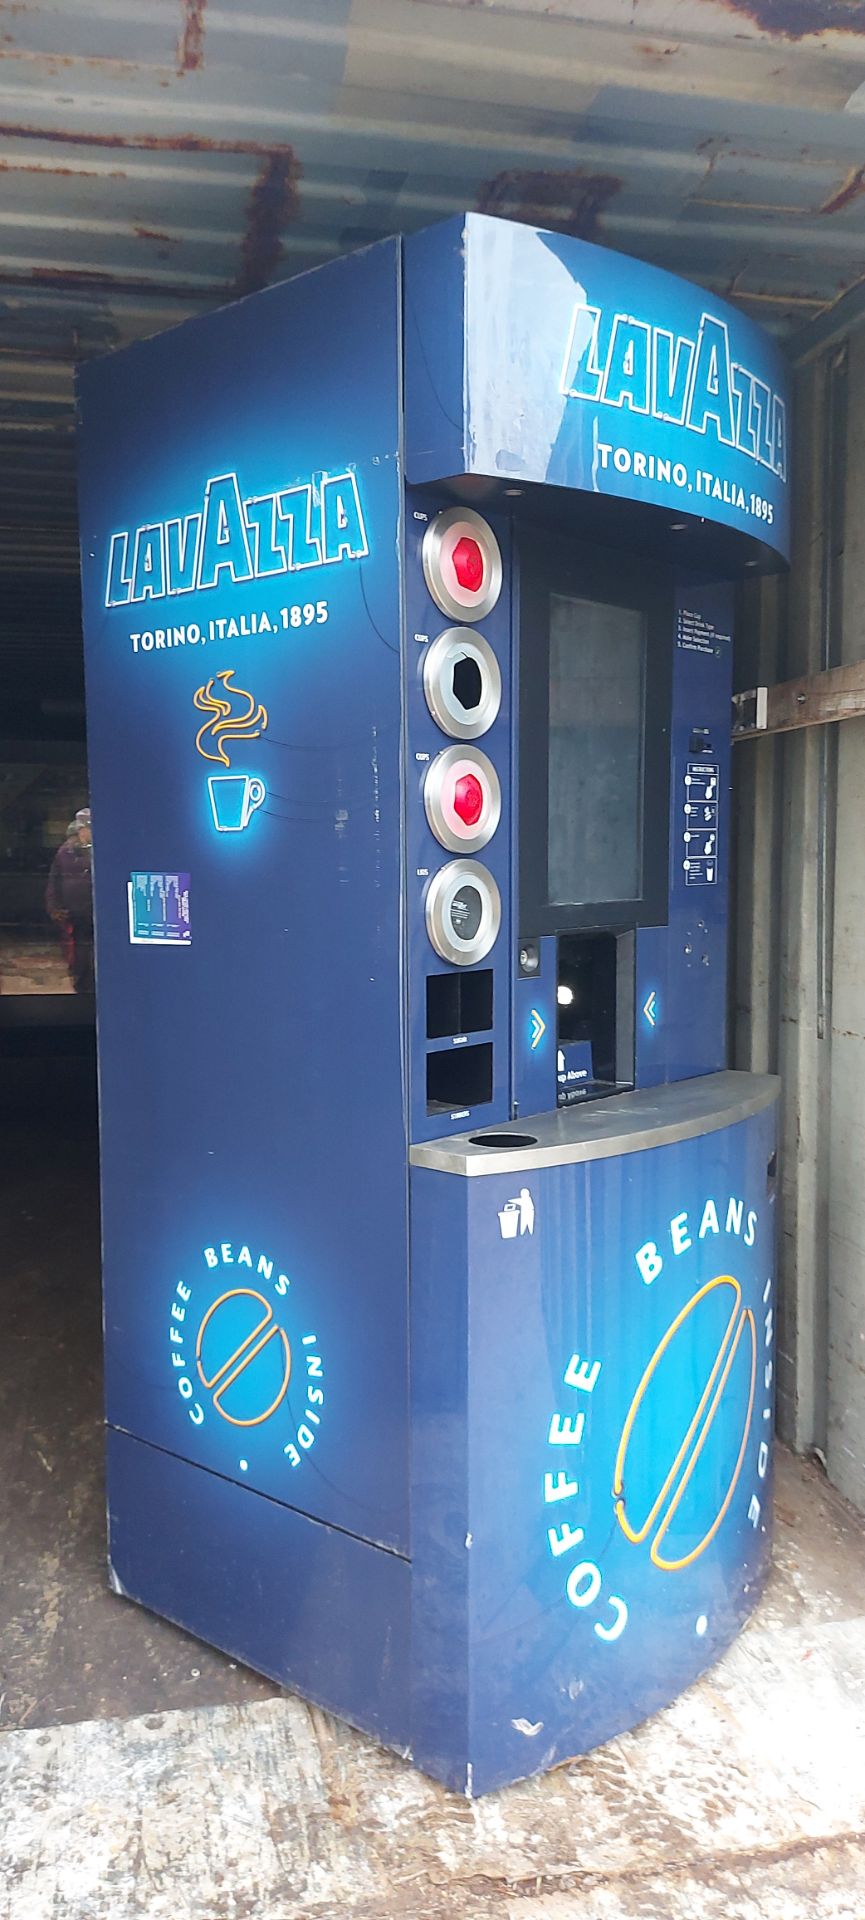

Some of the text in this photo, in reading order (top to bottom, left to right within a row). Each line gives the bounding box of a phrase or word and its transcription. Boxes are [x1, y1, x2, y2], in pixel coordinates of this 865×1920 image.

[560, 303, 787, 483] LAVAZZA
[105, 473, 368, 607] LAVAZZA
[598, 443, 774, 525] TORINO, ITALIA, 1895
[130, 601, 329, 654] TORINO, ITALIA, 1895
[567, 1069, 587, 1080] Above
[204, 1243, 290, 1296] BEANS
[635, 1197, 758, 1285] BEANS
[170, 1280, 205, 1425] COFFEE
[283, 1335, 324, 1467] INSIDE
[747, 1278, 773, 1529] INSIDE
[544, 1354, 629, 1641] COFFEE
